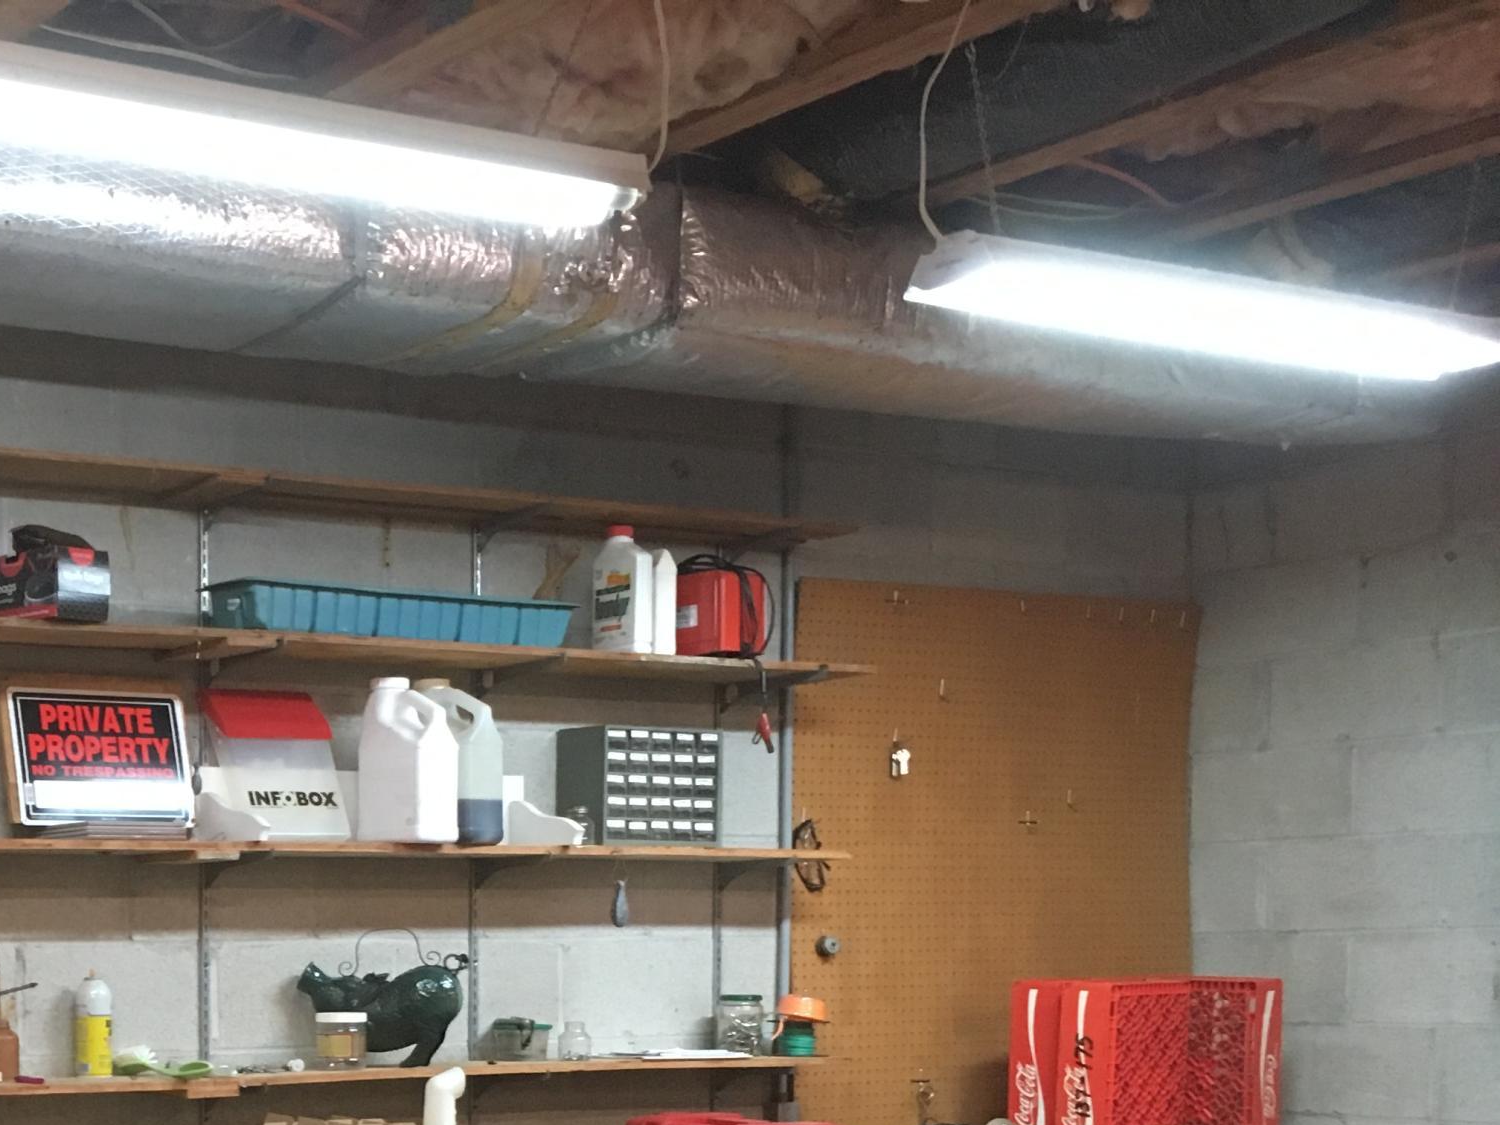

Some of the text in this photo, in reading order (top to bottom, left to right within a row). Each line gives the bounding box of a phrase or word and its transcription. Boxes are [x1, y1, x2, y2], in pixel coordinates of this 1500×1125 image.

[38, 703, 156, 735] PRIVATE
[27, 733, 170, 765] PROPERTY
[30, 764, 176, 779] NO TRESPASSING
